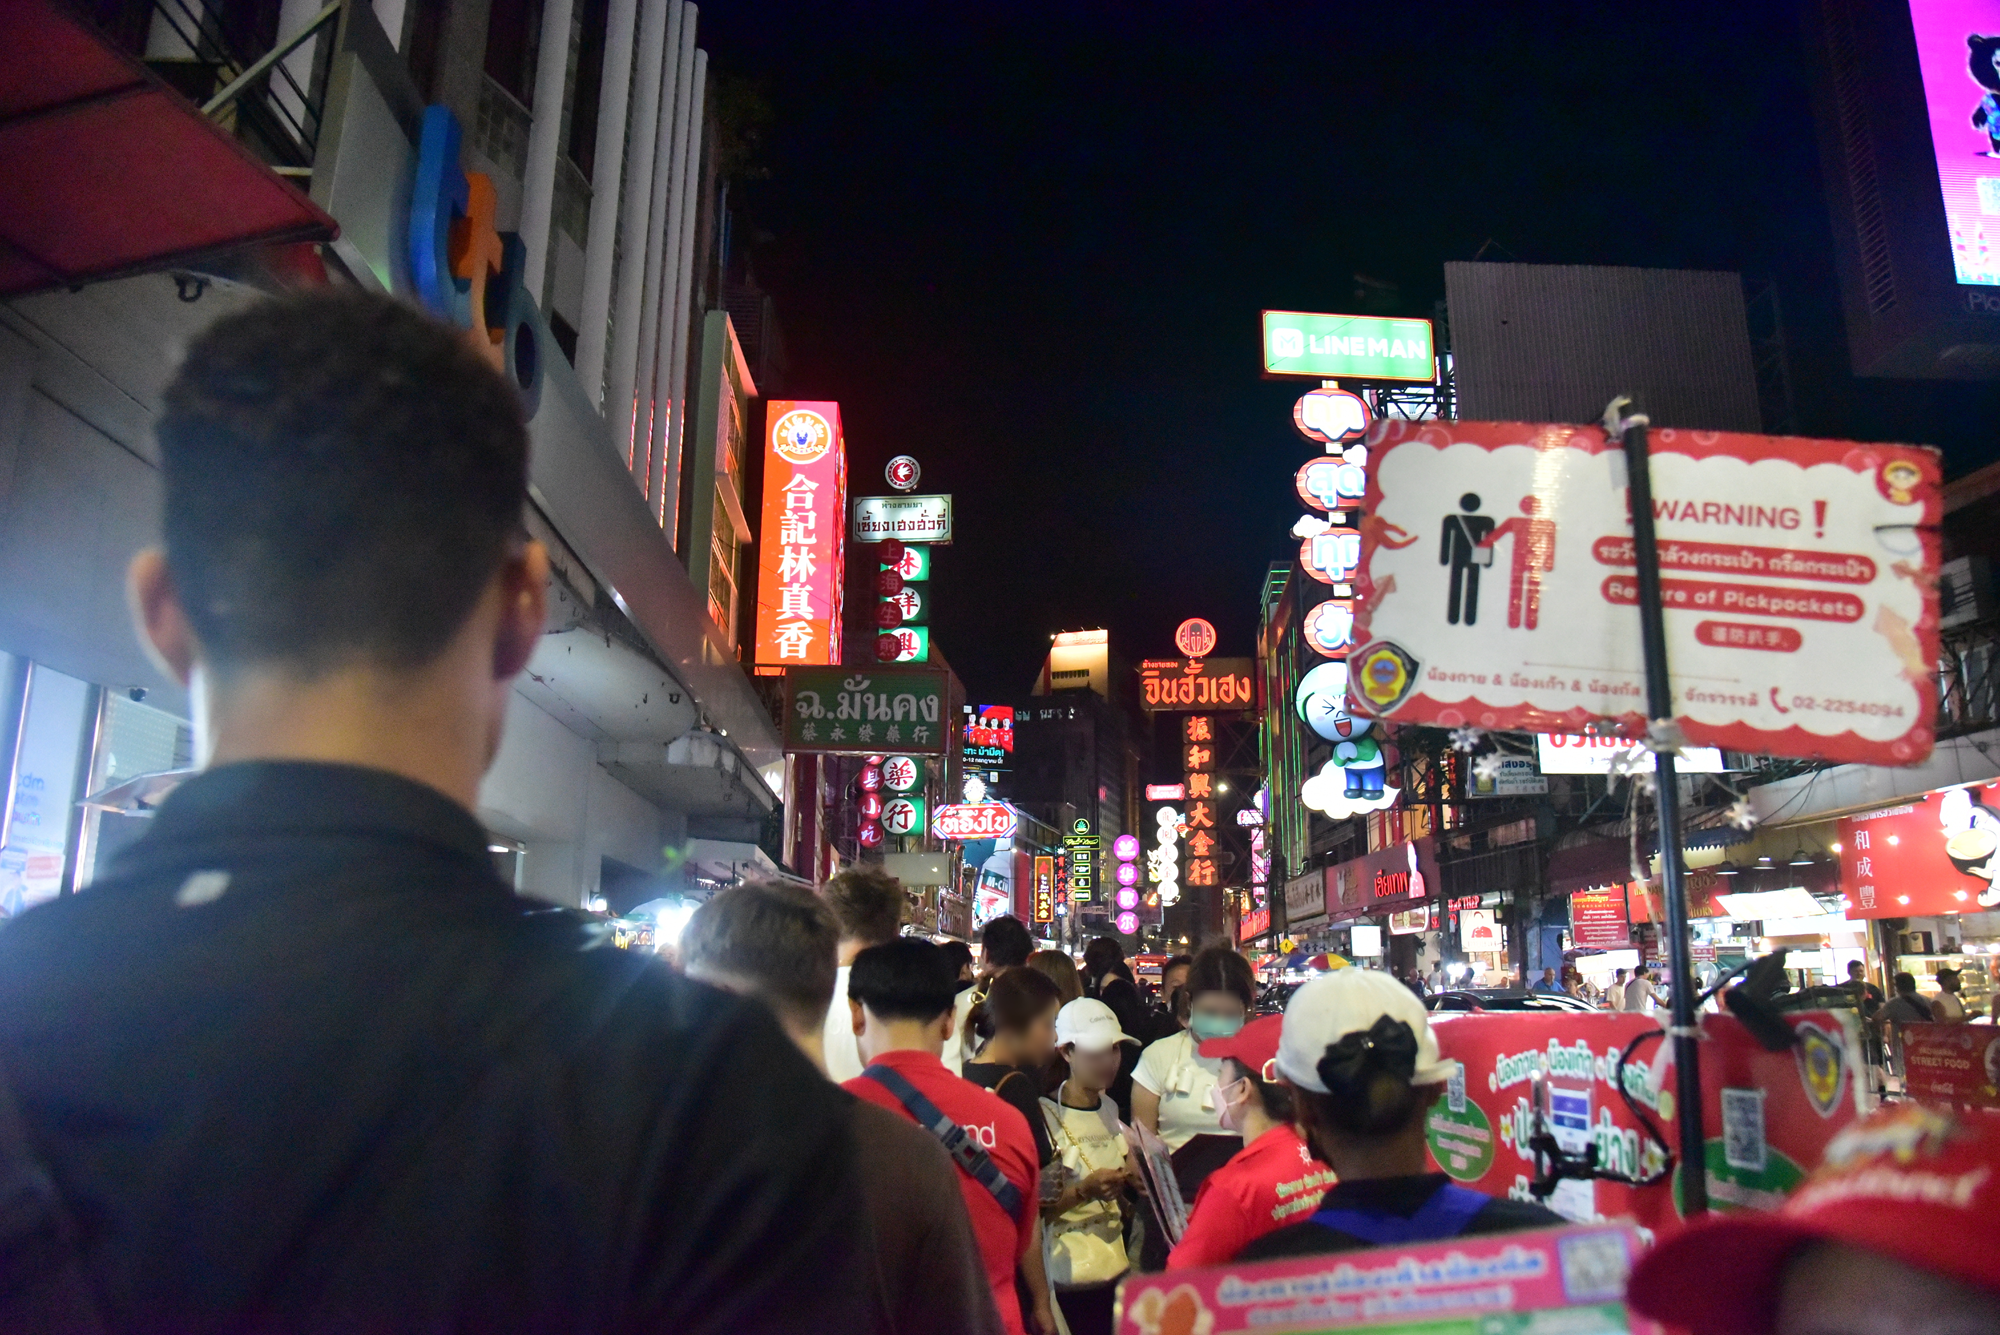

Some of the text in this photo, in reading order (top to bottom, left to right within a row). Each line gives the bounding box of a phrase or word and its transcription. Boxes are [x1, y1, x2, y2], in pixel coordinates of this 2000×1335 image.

[1309, 334, 1365, 358] LINE
[1368, 337, 1426, 360] MAN
[1651, 497, 1801, 531] WARNING
[775, 473, 819, 658] 合記林真香
[880, 543, 899, 656] 上海生煎
[1694, 589, 1717, 604] of
[1723, 590, 1858, 617] Pickpockets
[795, 674, 939, 722] ฉ.มั่นคง
[1427, 666, 1487, 685] น้องกาย
[1492, 674, 1503, 686] &
[1571, 679, 1582, 692] &
[1792, 695, 1904, 718] 02-2254094
[861, 756, 882, 843] 县小吃
[1187, 716, 1215, 885] 振和興大金行
[1119, 866, 1135, 931] 华歌尔
[1854, 829, 1877, 911] 和成豐
[1910, 1056, 1970, 1070] STREET FOOD
